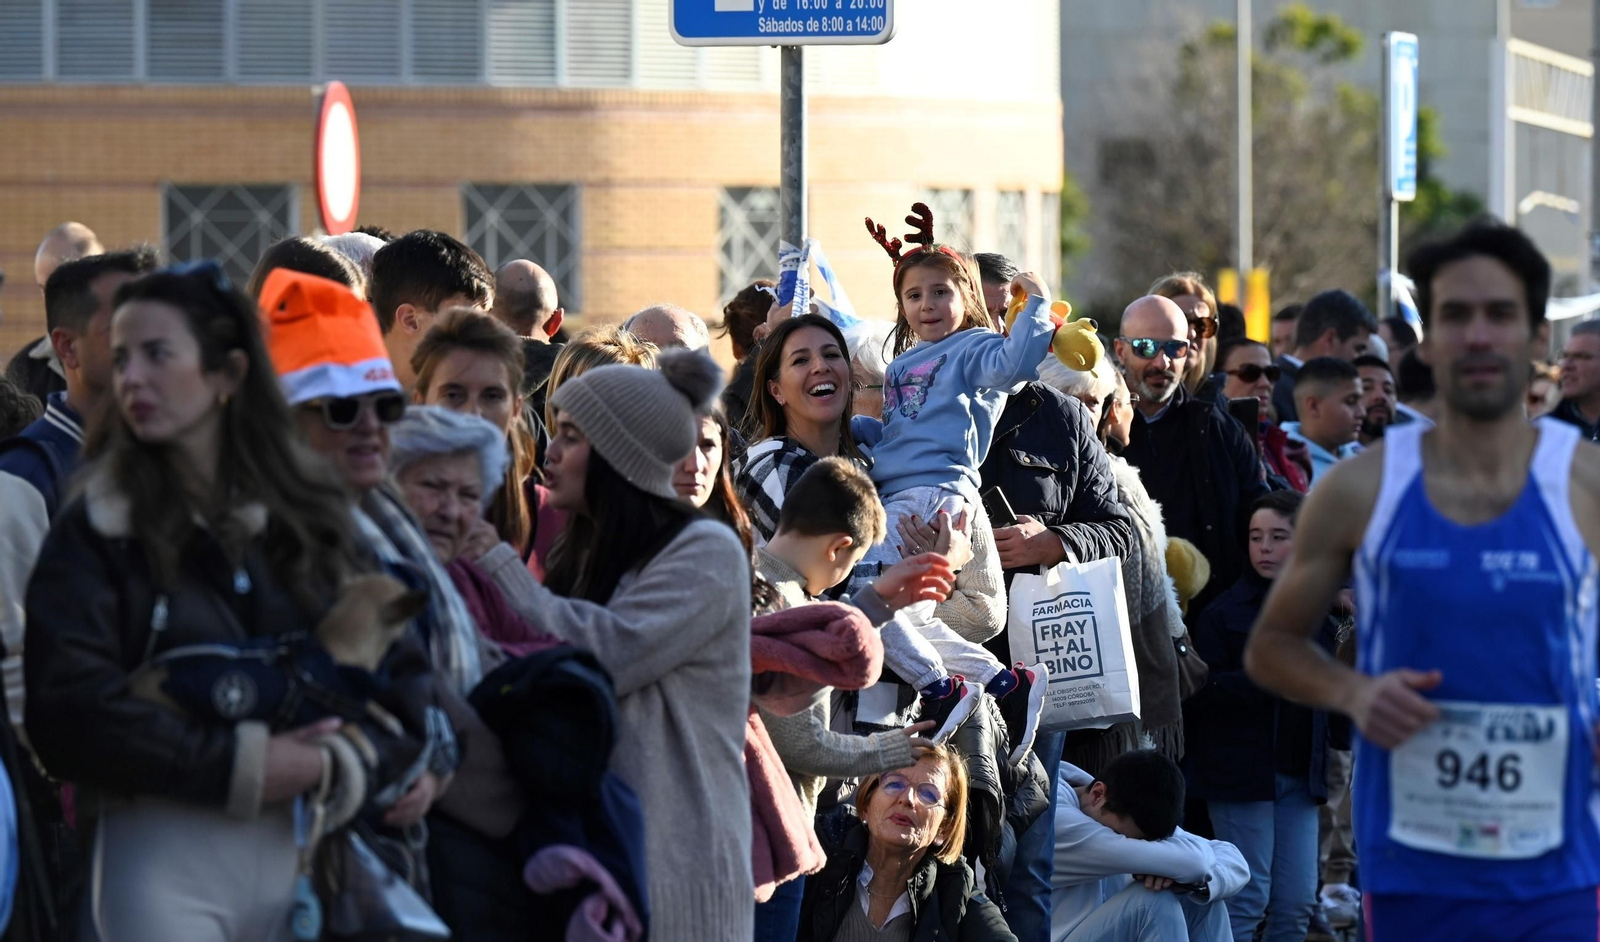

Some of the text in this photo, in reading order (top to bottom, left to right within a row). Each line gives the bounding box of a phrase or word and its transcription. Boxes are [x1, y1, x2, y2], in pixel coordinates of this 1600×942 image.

[758, 0, 765, 14] y
[772, 0, 787, 9] de
[835, 0, 842, 9] a
[758, 15, 884, 33] Sábados de 8:00 a 14:00
[1032, 598, 1093, 617] FARMACIA
[1040, 619, 1087, 641] FRAY
[1046, 654, 1093, 675] BINO
[1057, 687, 1077, 695] OBISPO
[1078, 683, 1101, 692] CUBERO,
[1435, 748, 1523, 794] 946
